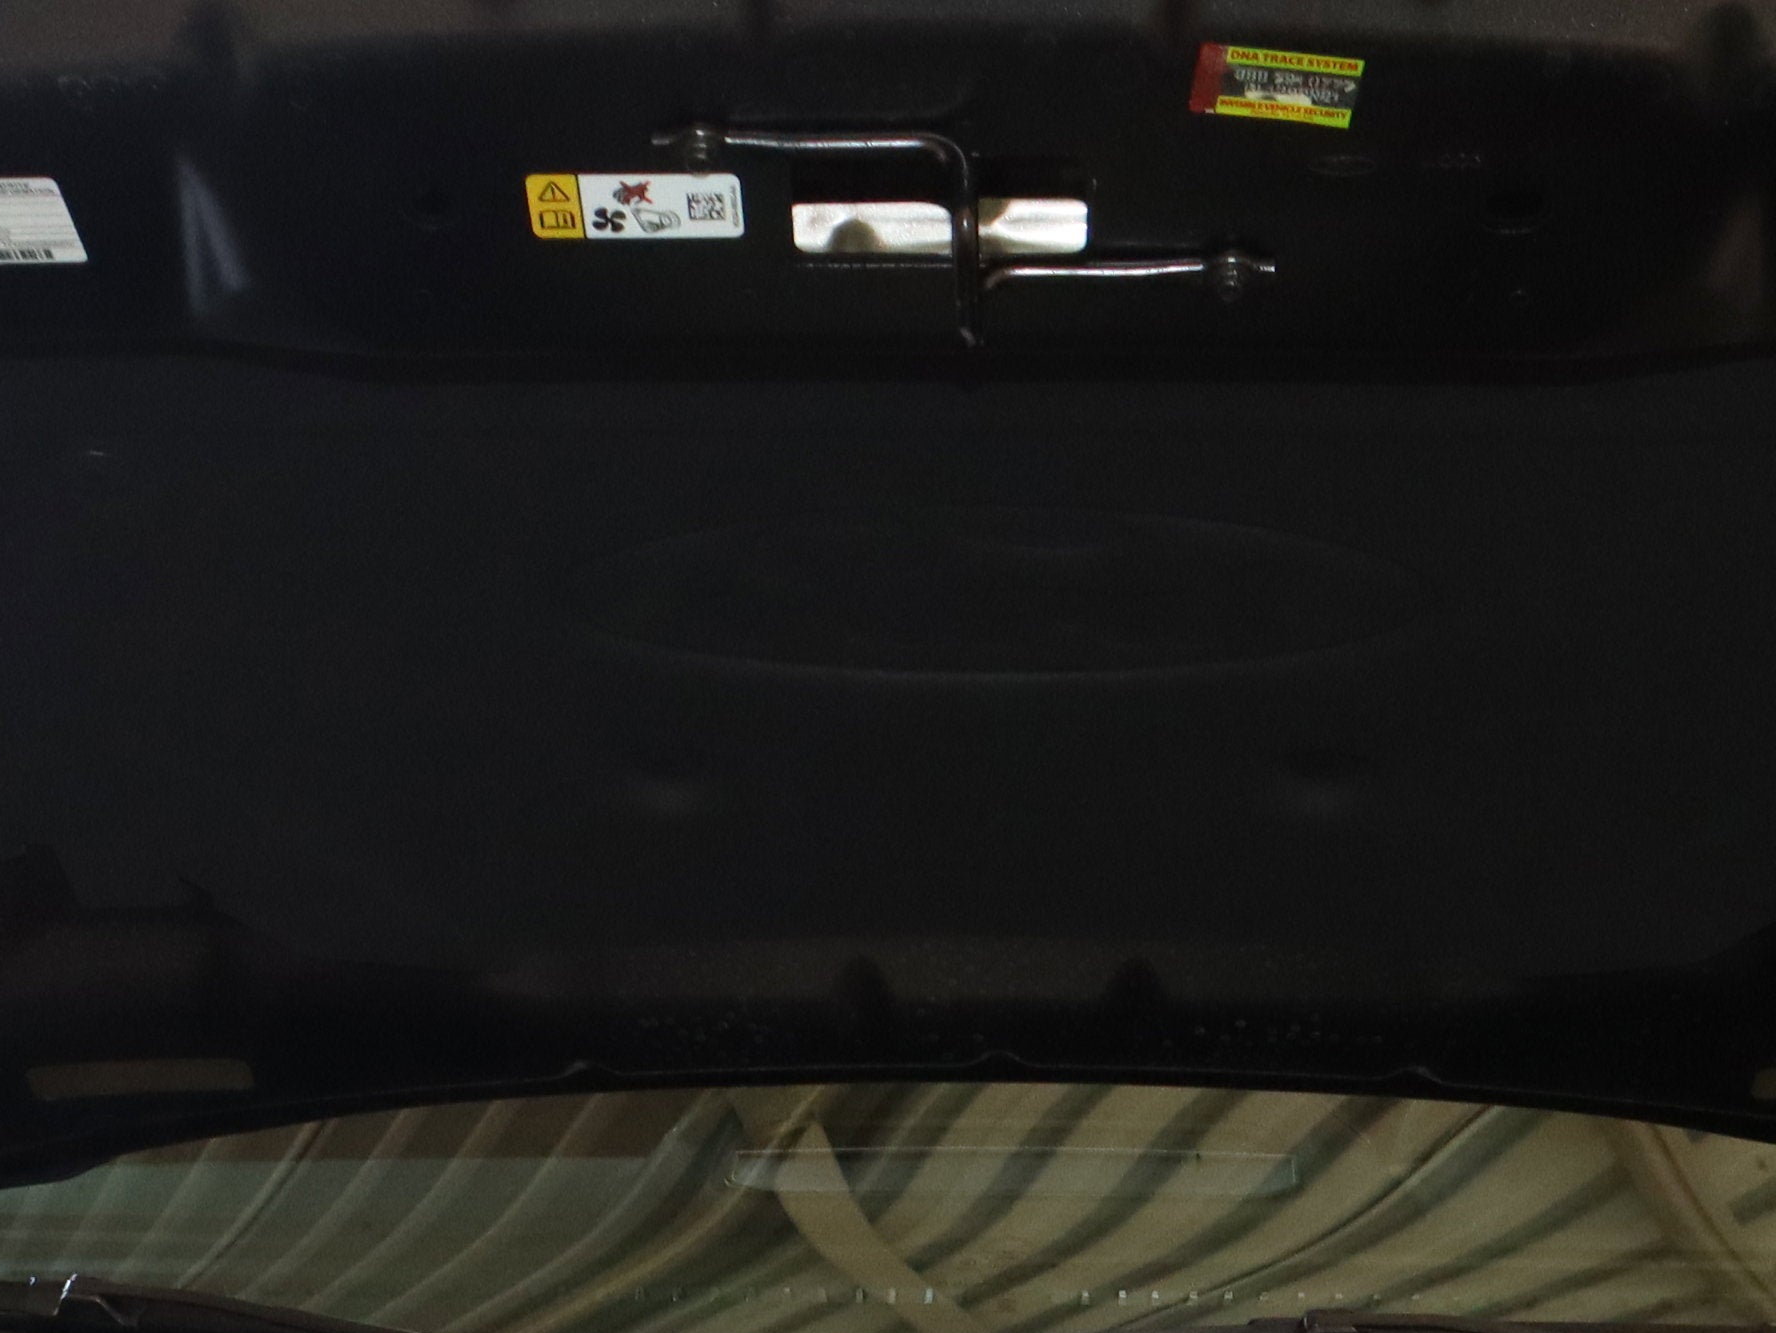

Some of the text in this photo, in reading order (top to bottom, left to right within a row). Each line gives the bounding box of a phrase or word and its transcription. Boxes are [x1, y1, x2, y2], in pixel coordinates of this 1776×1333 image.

[1230, 49, 1359, 72] DNA TRACE SYSTEM
